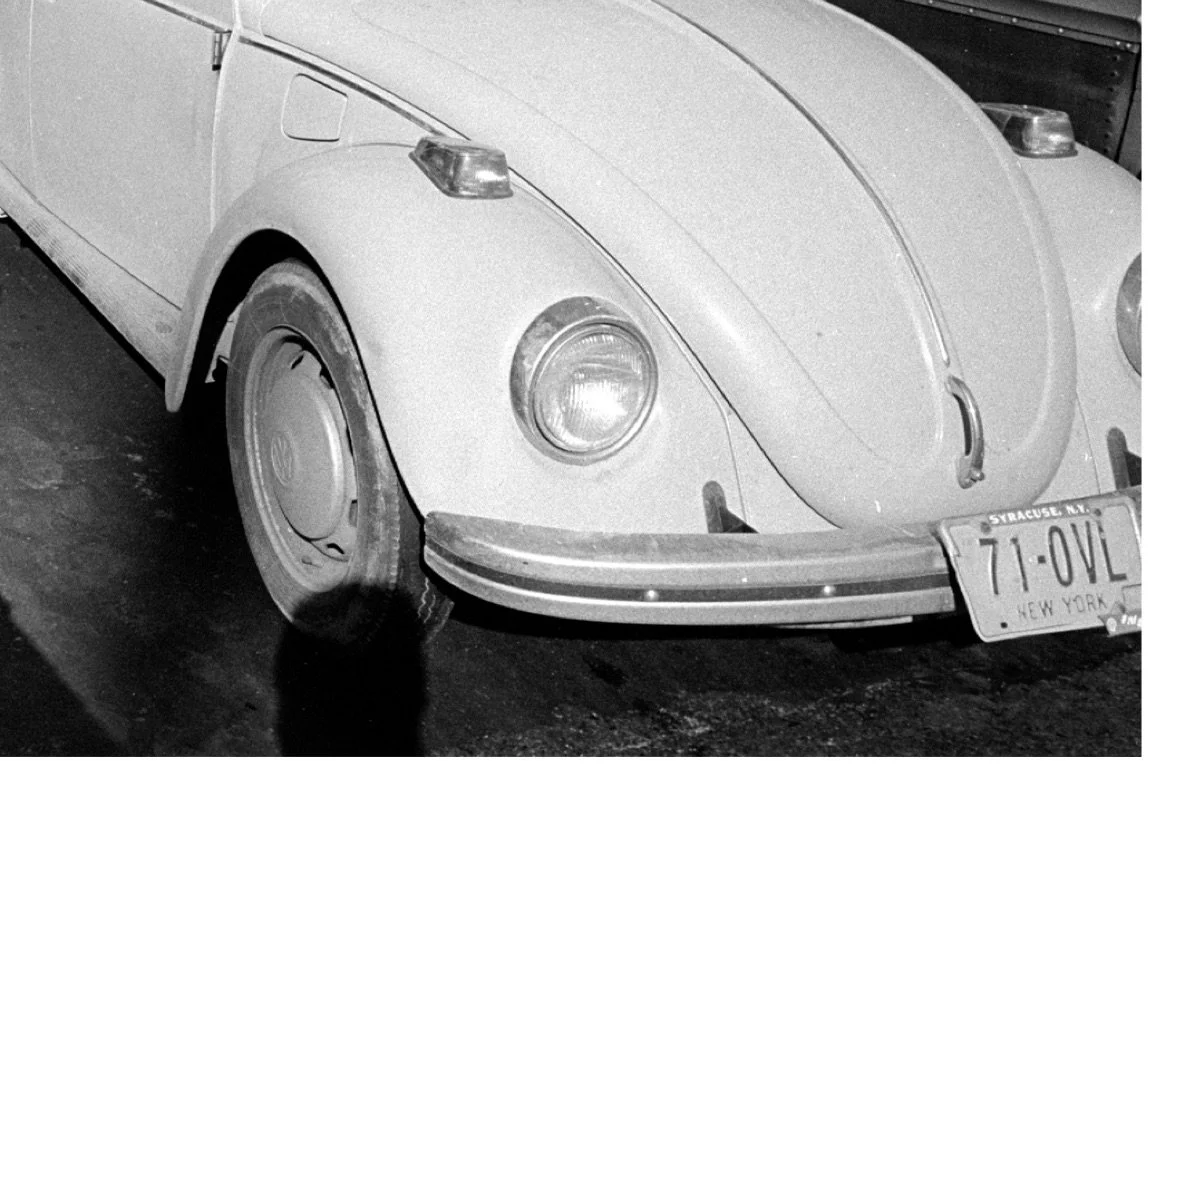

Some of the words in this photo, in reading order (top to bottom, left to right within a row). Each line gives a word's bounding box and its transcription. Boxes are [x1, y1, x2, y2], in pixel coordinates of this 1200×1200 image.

[978, 519, 1128, 596] 71-OVL
[1017, 599, 1054, 621] NEW
[1061, 592, 1108, 615] YORK
